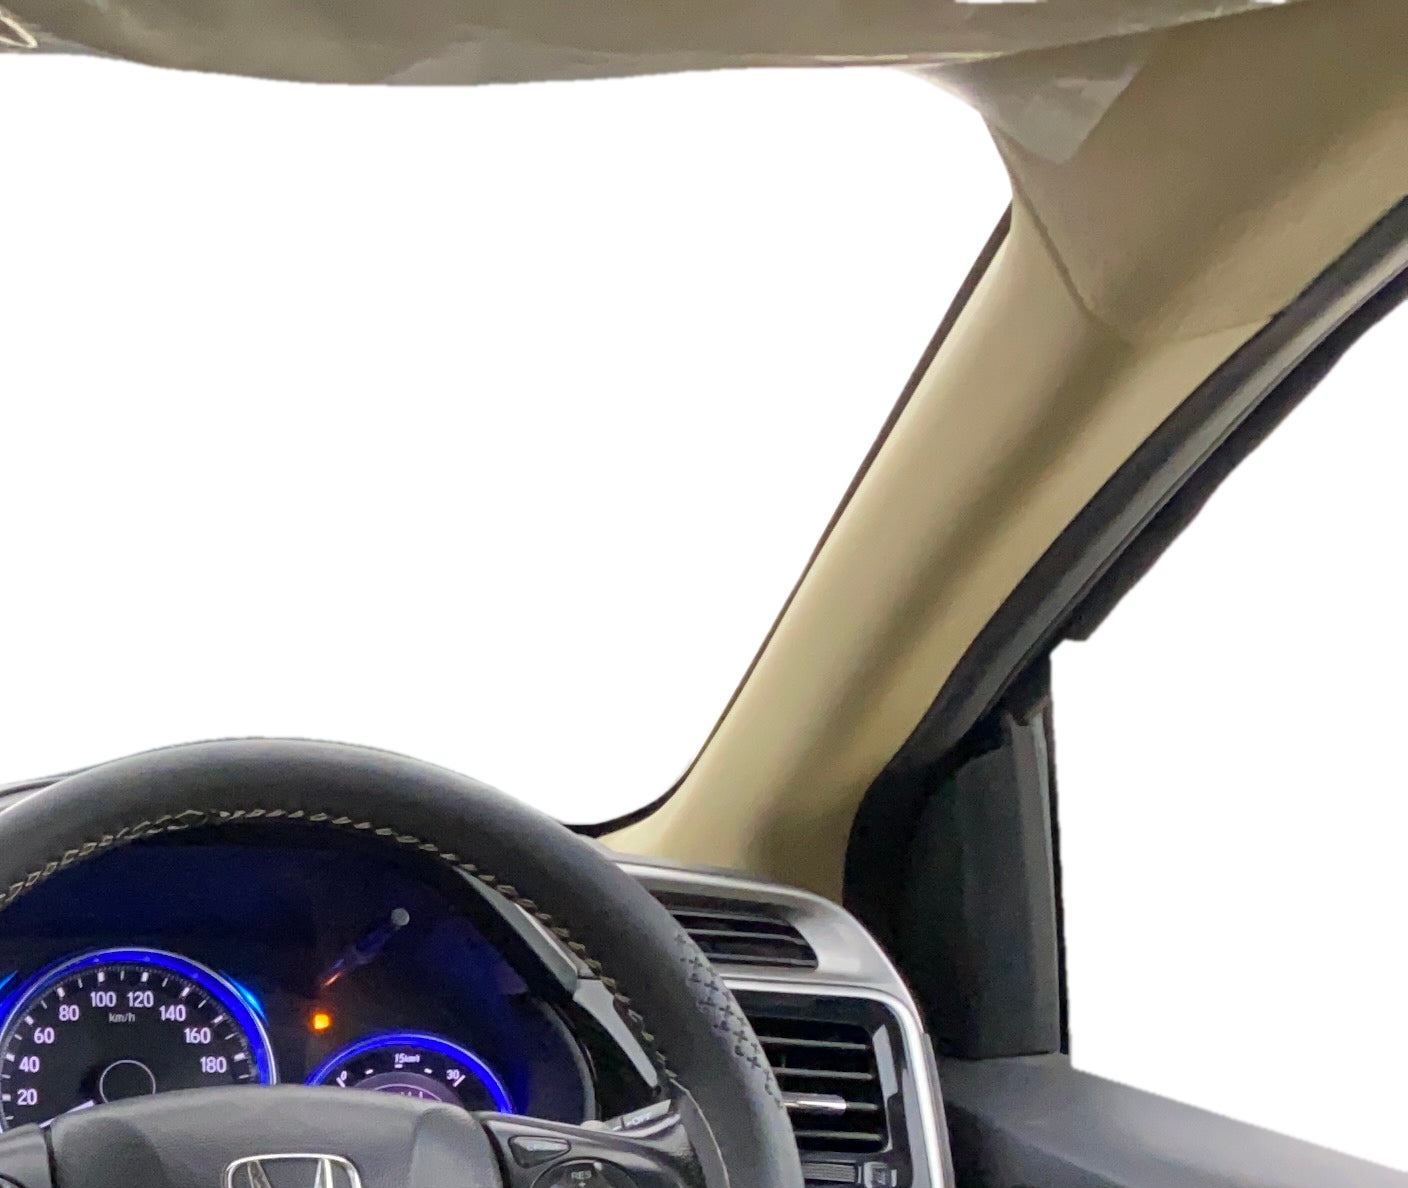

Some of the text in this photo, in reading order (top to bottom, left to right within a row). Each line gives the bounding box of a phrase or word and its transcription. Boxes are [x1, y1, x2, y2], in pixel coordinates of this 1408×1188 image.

[90, 991, 117, 1008] 100
[126, 990, 154, 1008] 120
[58, 1004, 80, 1021] 80
[108, 1011, 136, 1023] km/h
[159, 1004, 186, 1022] 140
[33, 1027, 55, 1044] 60
[184, 1027, 211, 1044] 160
[18, 1056, 40, 1073] 40
[200, 1056, 227, 1073] 180
[340, 1070, 348, 1081] 0
[446, 1069, 460, 1080] 30
[17, 1088, 38, 1106] 20
